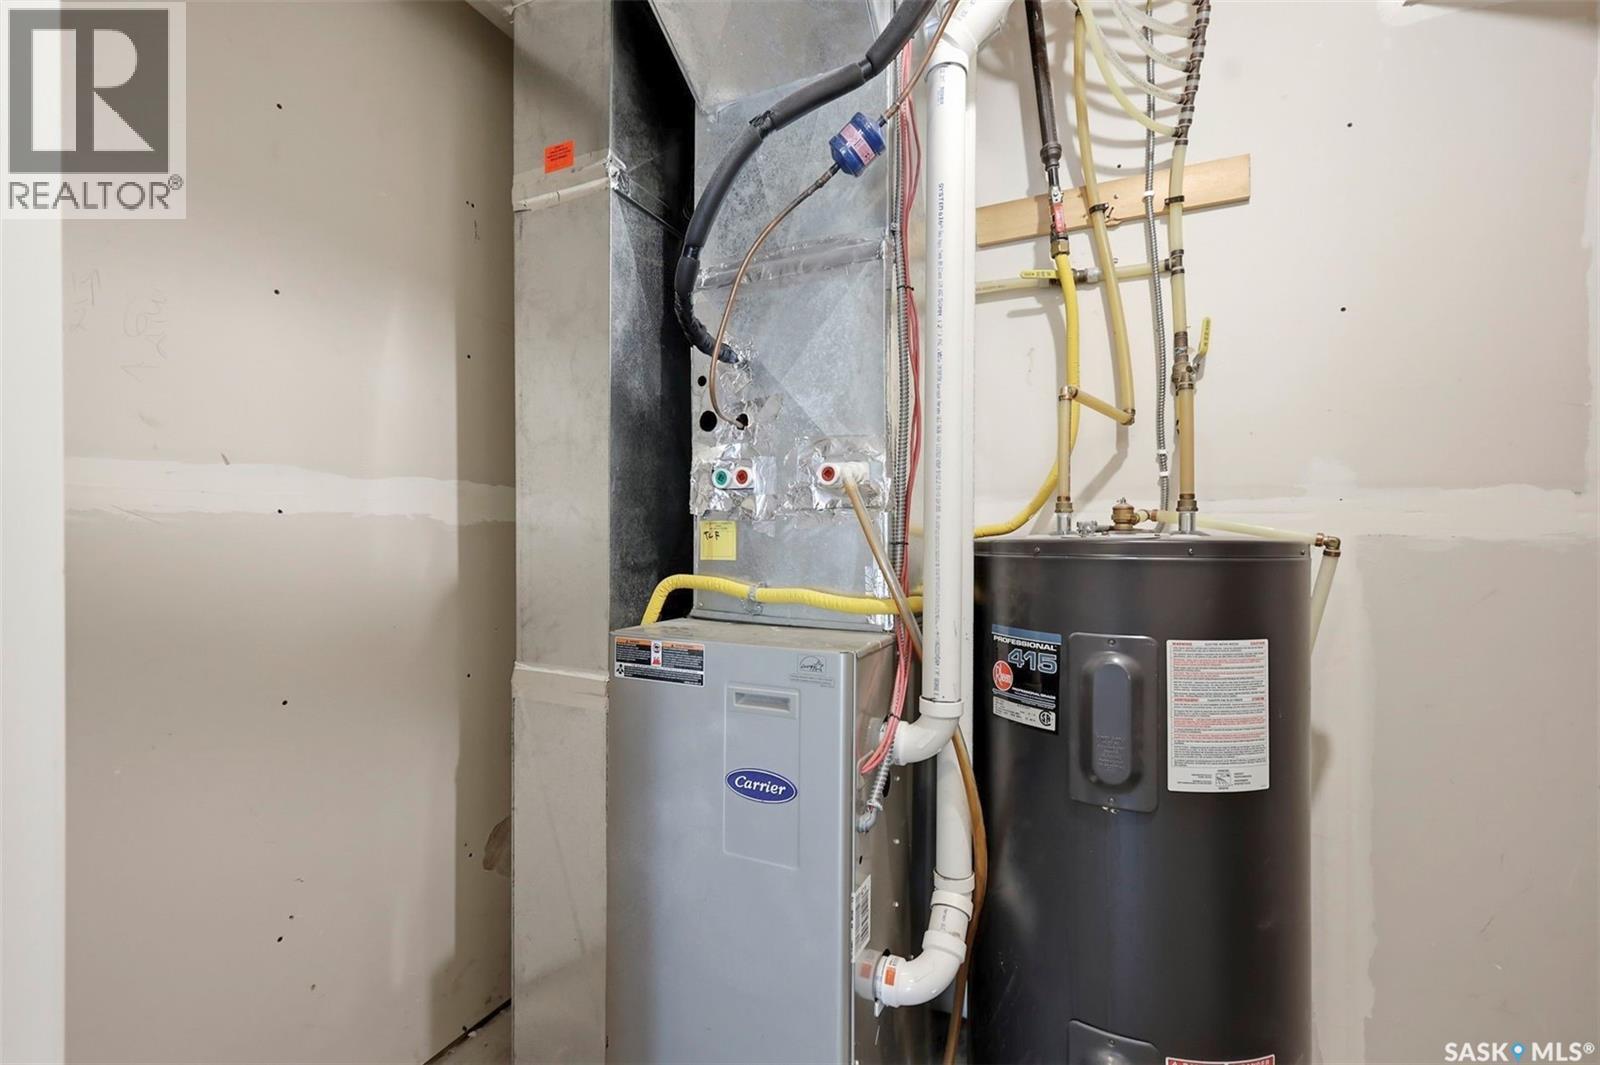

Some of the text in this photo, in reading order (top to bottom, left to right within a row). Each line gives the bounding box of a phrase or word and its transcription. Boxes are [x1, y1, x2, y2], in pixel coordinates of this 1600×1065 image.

[993, 635, 1057, 652] PROFESSIONAL
[1007, 648, 1058, 674] 415
[734, 775, 786, 795] Carrier
